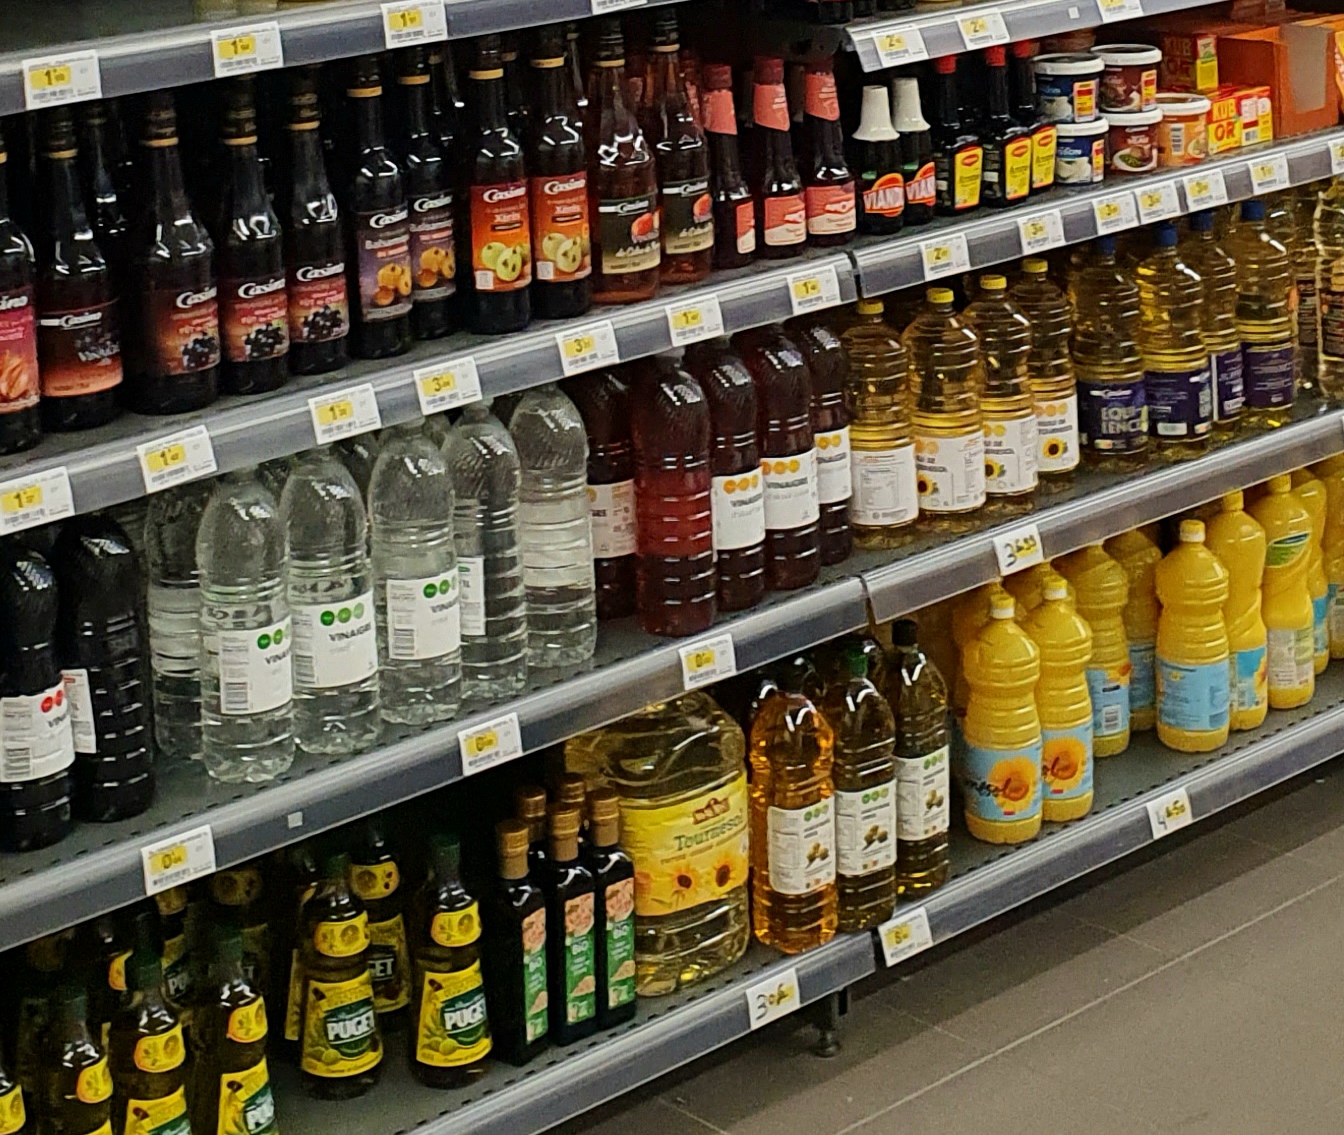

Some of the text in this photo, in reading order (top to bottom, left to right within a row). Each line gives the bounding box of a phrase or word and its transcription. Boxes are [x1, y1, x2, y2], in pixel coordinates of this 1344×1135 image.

[1211, 98, 1238, 121] KUB
[1214, 122, 1236, 142] OR
[60, 312, 102, 328] Casino
[673, 807, 744, 852] Tournesol
